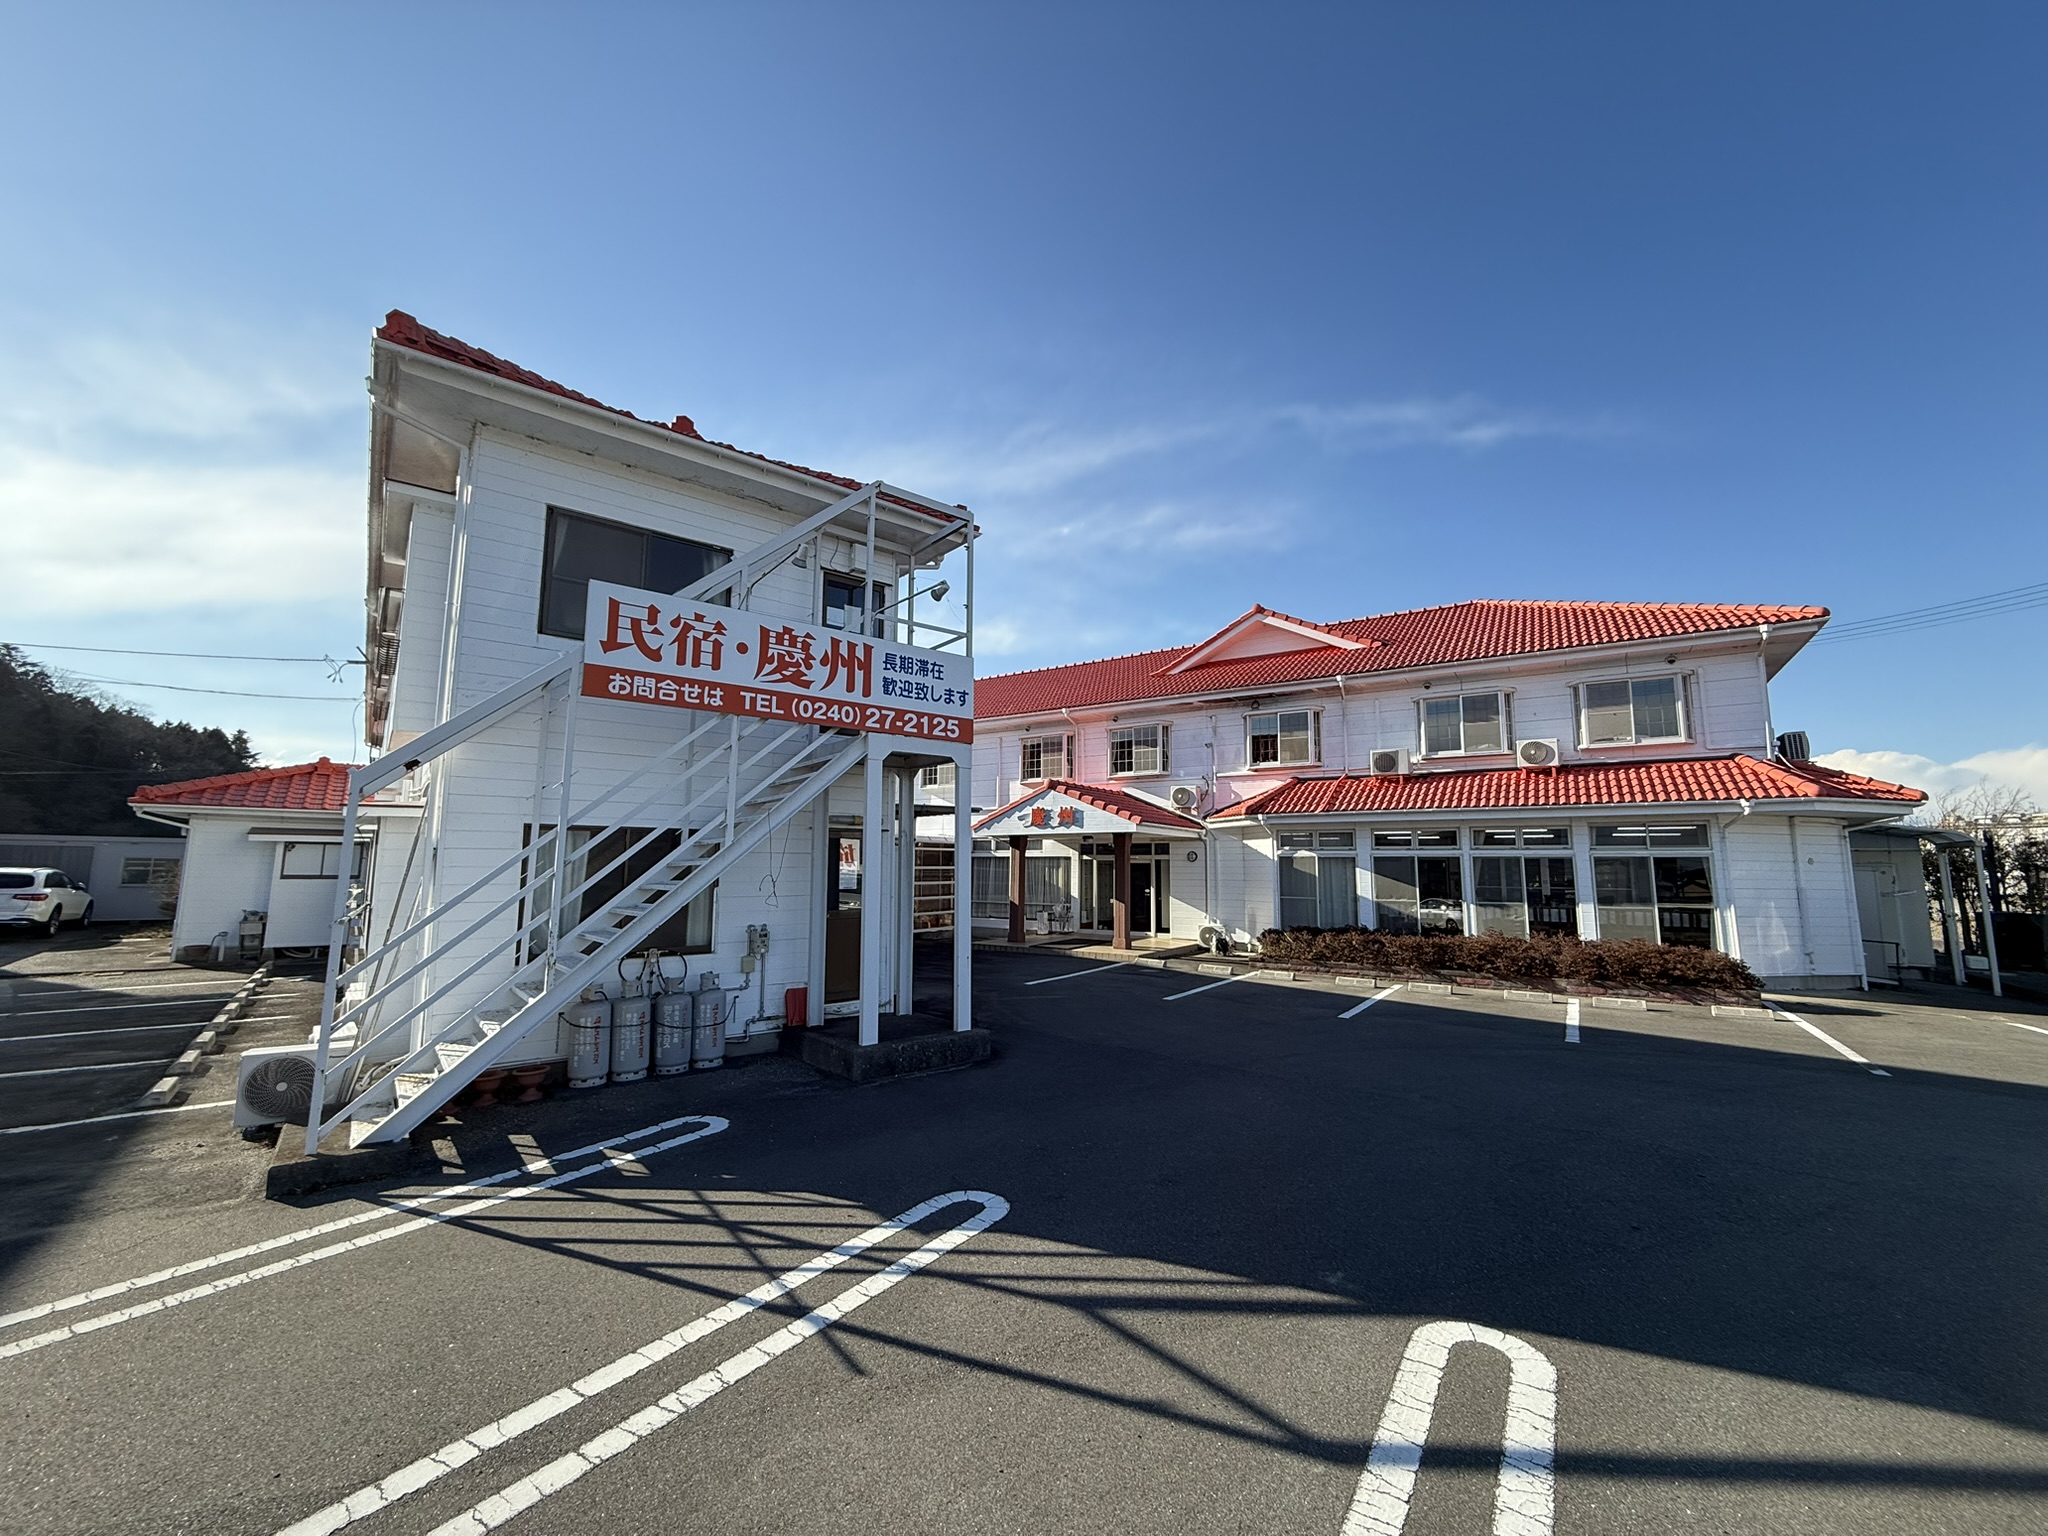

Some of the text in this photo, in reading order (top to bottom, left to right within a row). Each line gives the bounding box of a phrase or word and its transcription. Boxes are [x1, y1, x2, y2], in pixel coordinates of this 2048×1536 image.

[600, 597, 874, 698] 民宿・慶州
[882, 652, 945, 681] 長期滞在
[608, 673, 724, 706] お問合せは
[740, 691, 785, 715] TEL
[882, 676, 969, 707] 歓迎致します
